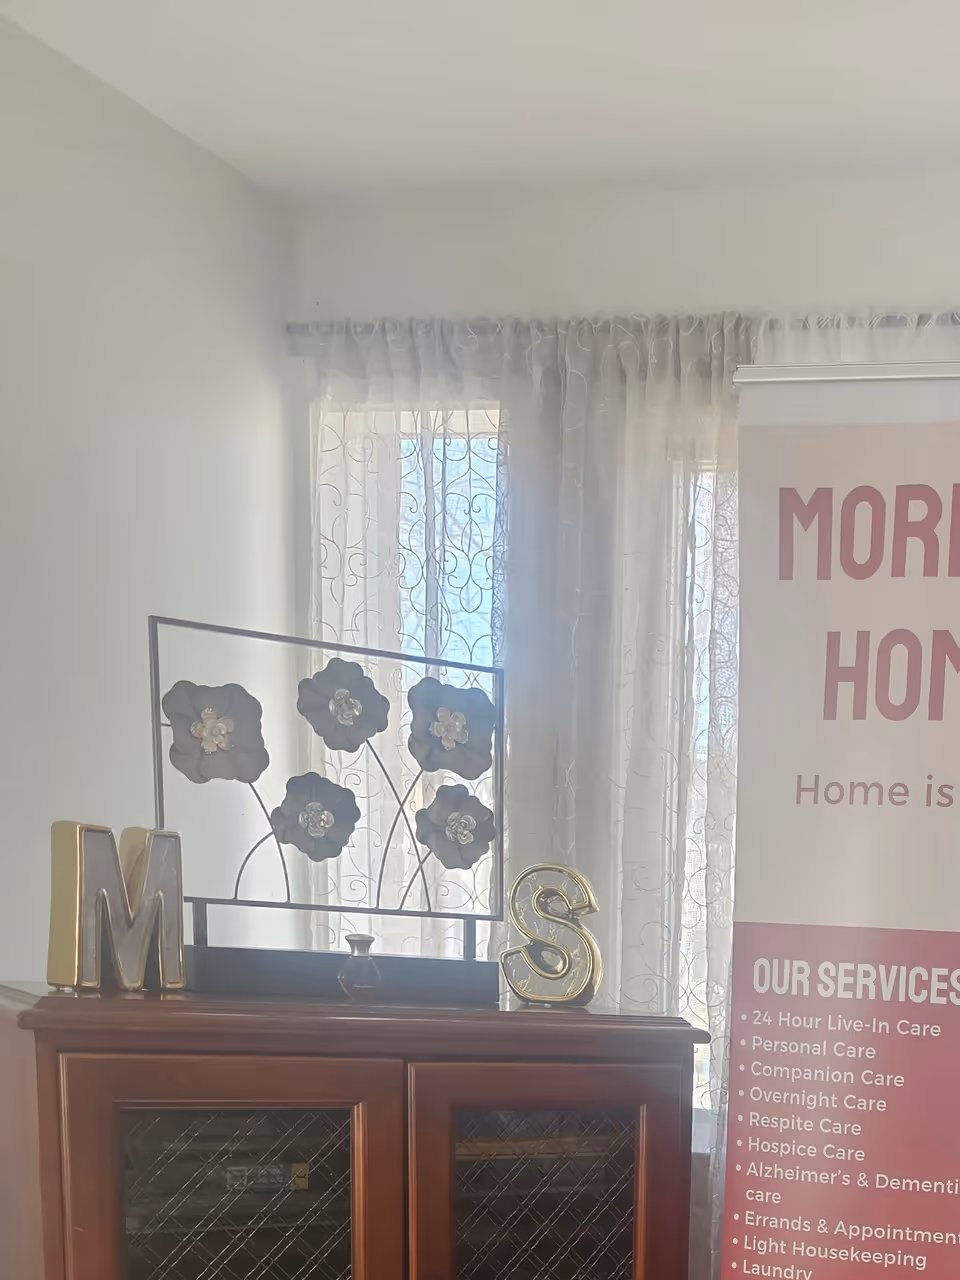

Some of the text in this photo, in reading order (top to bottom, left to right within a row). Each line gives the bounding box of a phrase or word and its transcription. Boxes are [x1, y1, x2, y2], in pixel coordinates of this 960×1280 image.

[794, 773, 910, 809] Home
[924, 773, 955, 809] is
[753, 957, 811, 996] OUR
[752, 1010, 942, 1037] 24 Hour Live-In Care
[752, 1035, 876, 1059] Personal Care
[750, 1061, 905, 1087] Companion Care
[749, 1086, 887, 1112] Overnight Care
[749, 1111, 862, 1136] Respite Care
[747, 1136, 866, 1162] Hospice Care
[746, 1161, 851, 1186] Alzheimer's
[857, 1172, 869, 1188] &
[745, 1188, 782, 1204] care
[745, 1210, 811, 1232] Errands
[817, 1219, 829, 1234] &
[743, 1235, 928, 1271] Light Housekeeping
